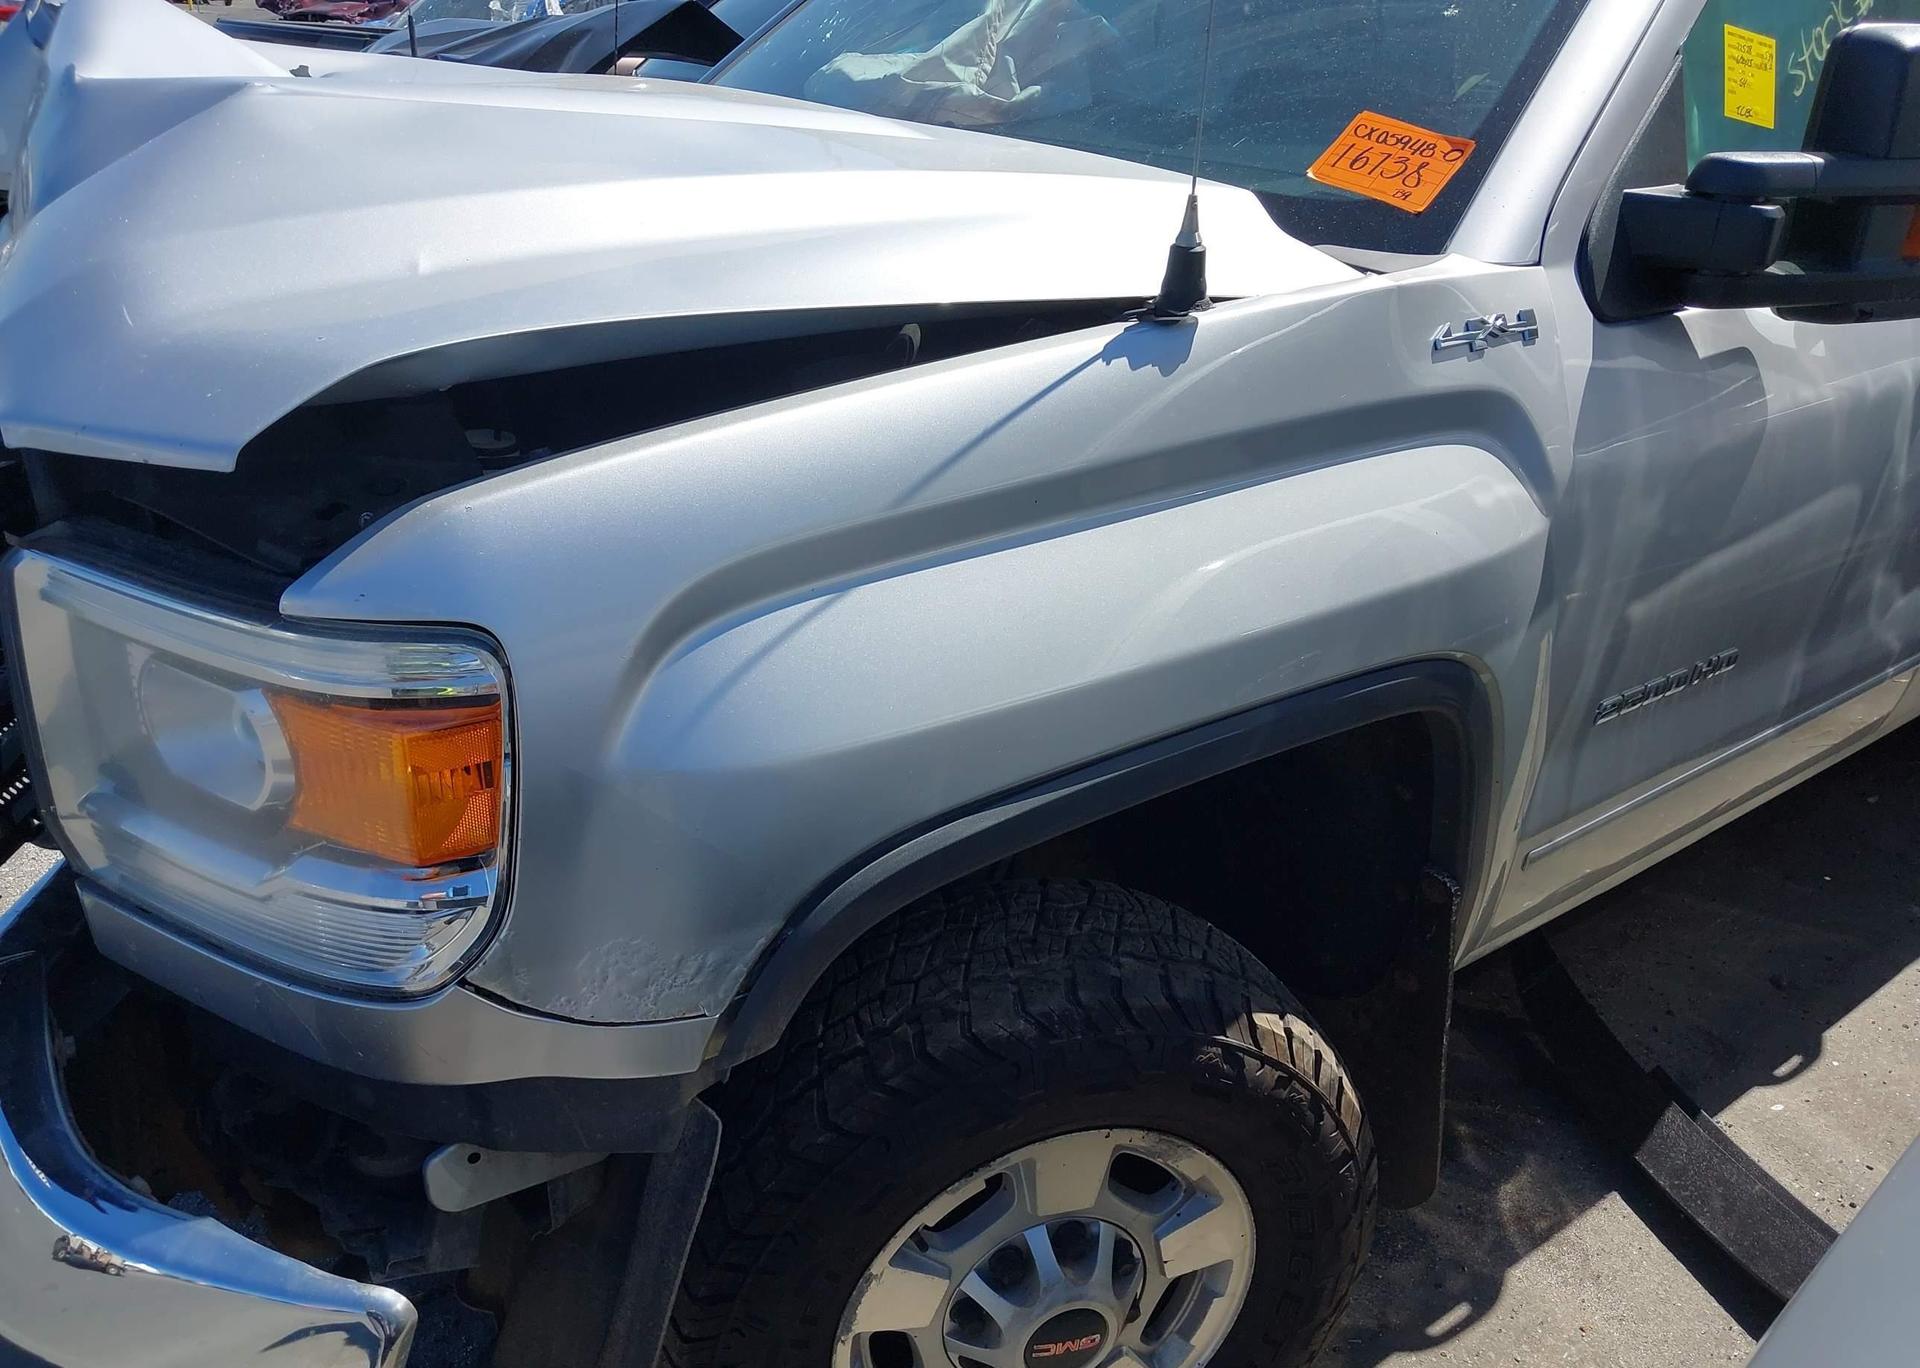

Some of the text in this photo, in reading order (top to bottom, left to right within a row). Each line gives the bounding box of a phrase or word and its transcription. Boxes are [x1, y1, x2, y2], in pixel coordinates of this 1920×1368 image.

[1331, 142, 1430, 189] 16738
[1593, 647, 1740, 726] 2500HD
[1031, 1333, 1101, 1358] GMC
